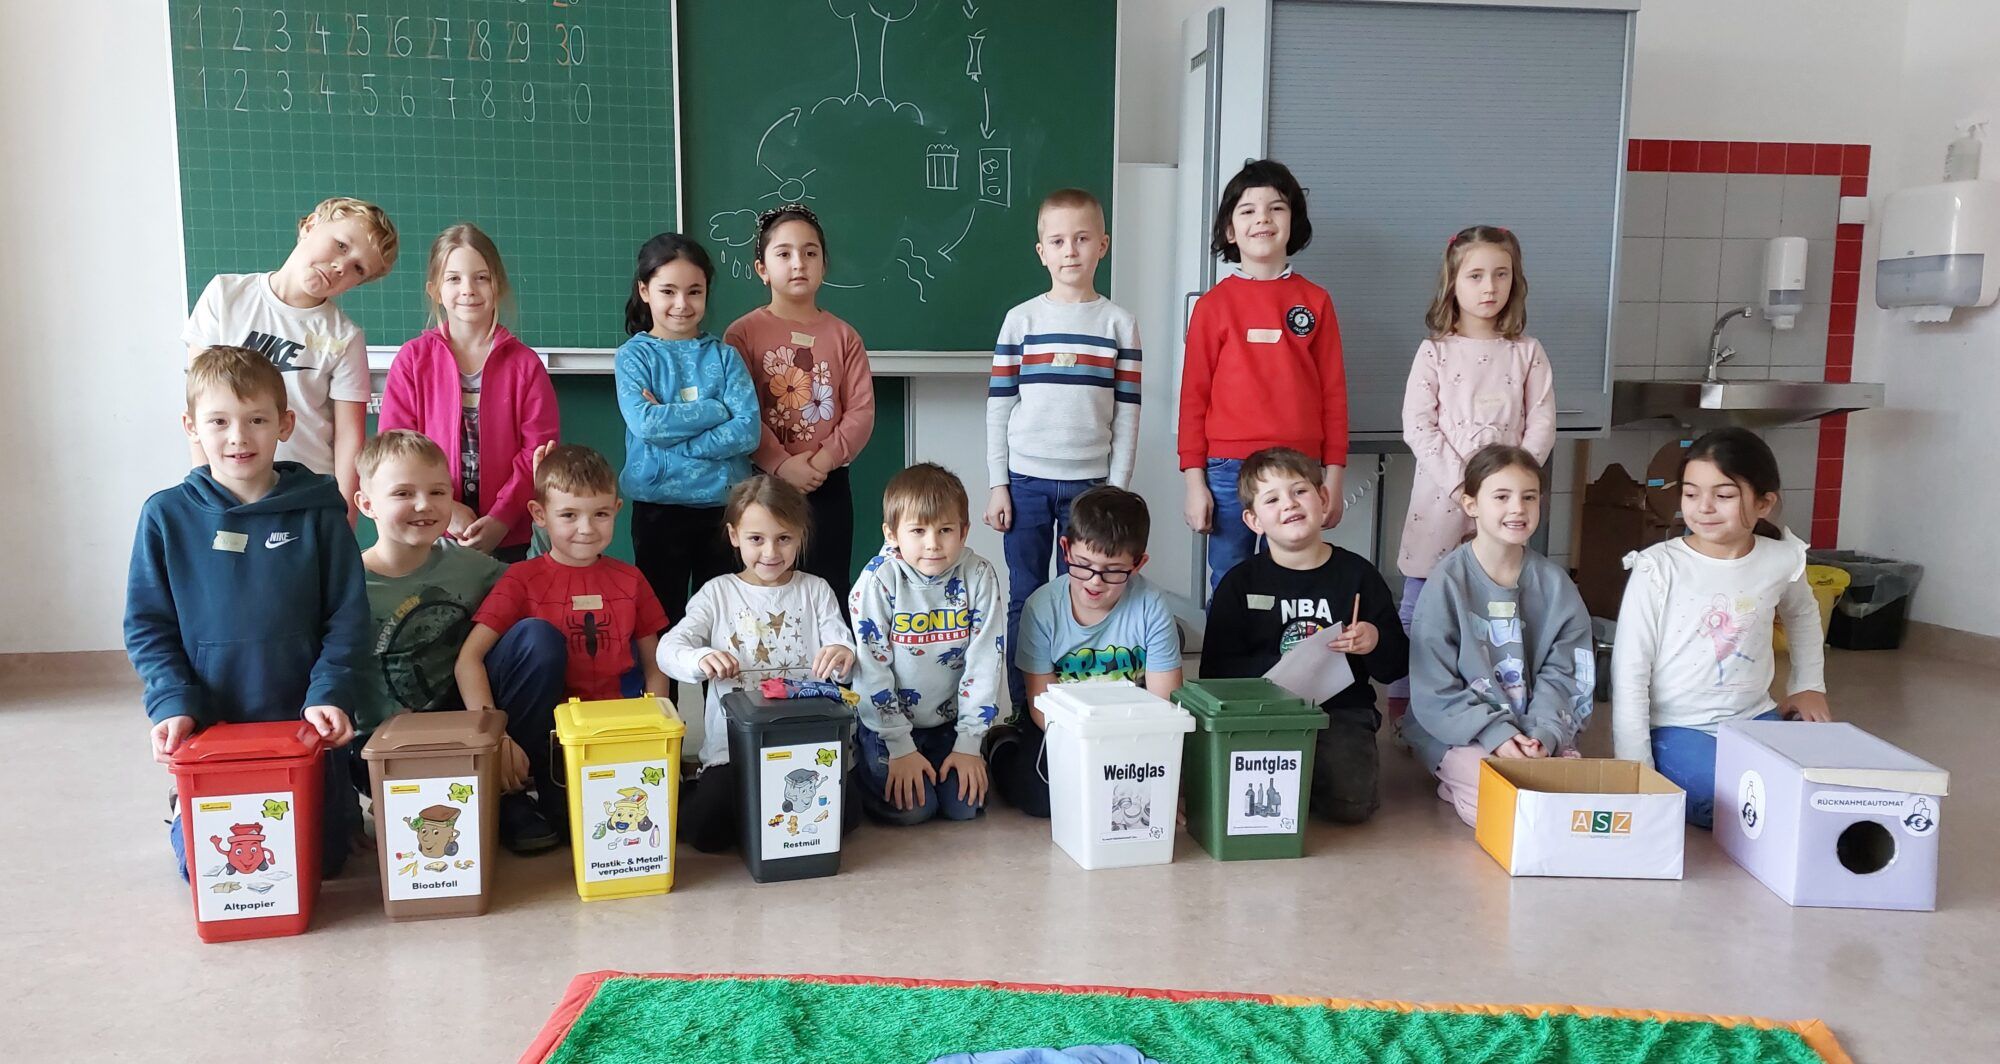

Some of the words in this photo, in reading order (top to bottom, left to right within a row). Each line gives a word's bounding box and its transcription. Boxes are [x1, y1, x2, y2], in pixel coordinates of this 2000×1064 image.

[555, 23, 585, 65] 30
[441, 78, 457, 119] 7
[481, 79, 496, 119] 8
[522, 82, 536, 122] 9
[574, 83, 592, 124] 0
[982, 157, 1001, 197] BIO
[241, 330, 305, 369] NIKE
[269, 532, 290, 542] NIKE
[894, 609, 970, 633] SONIC
[1280, 598, 1333, 625] NBA
[892, 634, 912, 643] THE
[1104, 762, 1165, 783] Weißglas
[1235, 755, 1297, 775] Buntglas
[1817, 798, 1904, 807] RÜCKNAHMEAUTOMAT
[1573, 812, 1631, 831] ASZ
[783, 838, 820, 849] Restmüll
[591, 859, 625, 869] Plastik-
[636, 855, 668, 864] Metall-
[598, 863, 661, 876] verpackungen
[412, 880, 458, 890] Bioabfall
[223, 900, 275, 912] Altpapier
